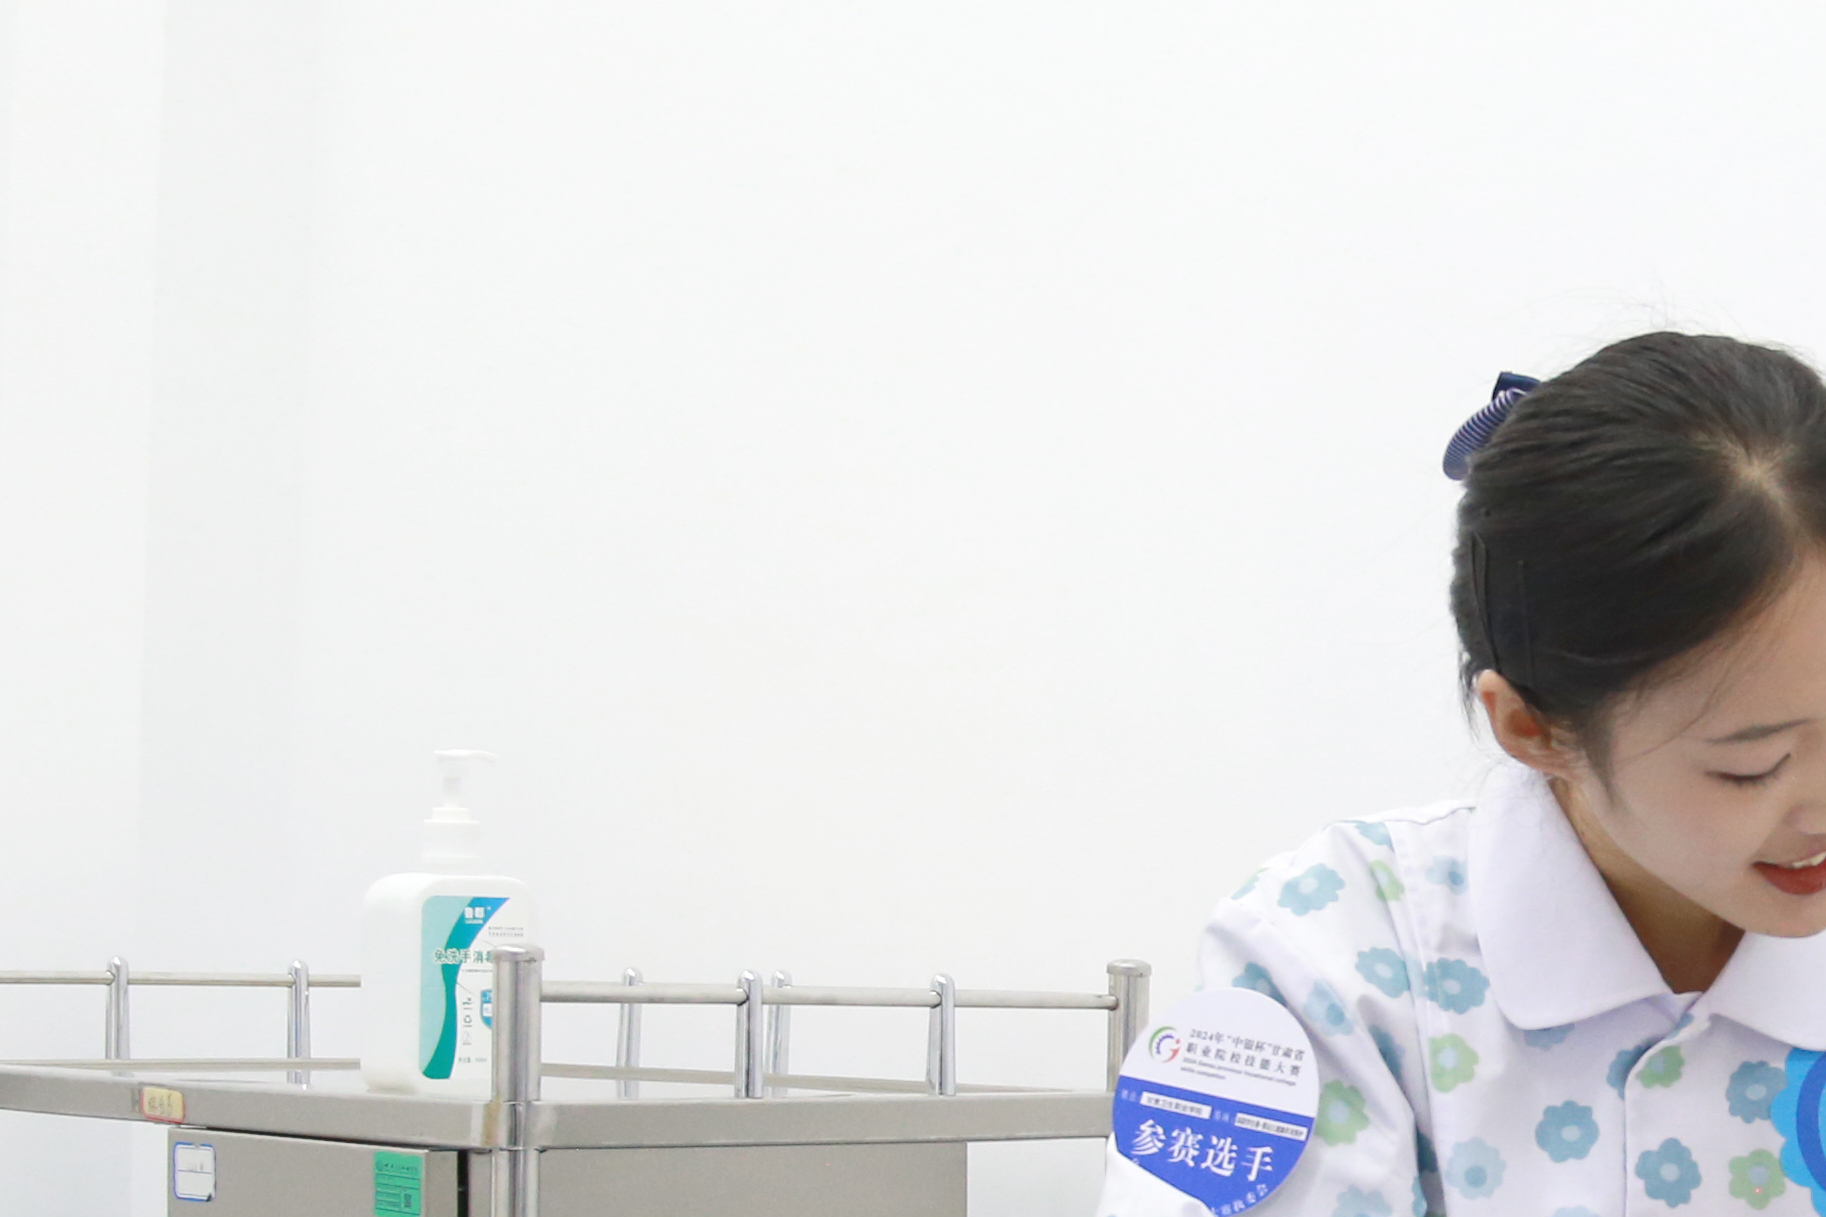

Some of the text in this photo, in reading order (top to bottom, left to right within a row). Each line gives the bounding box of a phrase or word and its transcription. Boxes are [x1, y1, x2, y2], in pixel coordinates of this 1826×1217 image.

[1186, 1042, 1301, 1077] 职业院校技能大赛
[1131, 1119, 1274, 1182] 参赛选手
